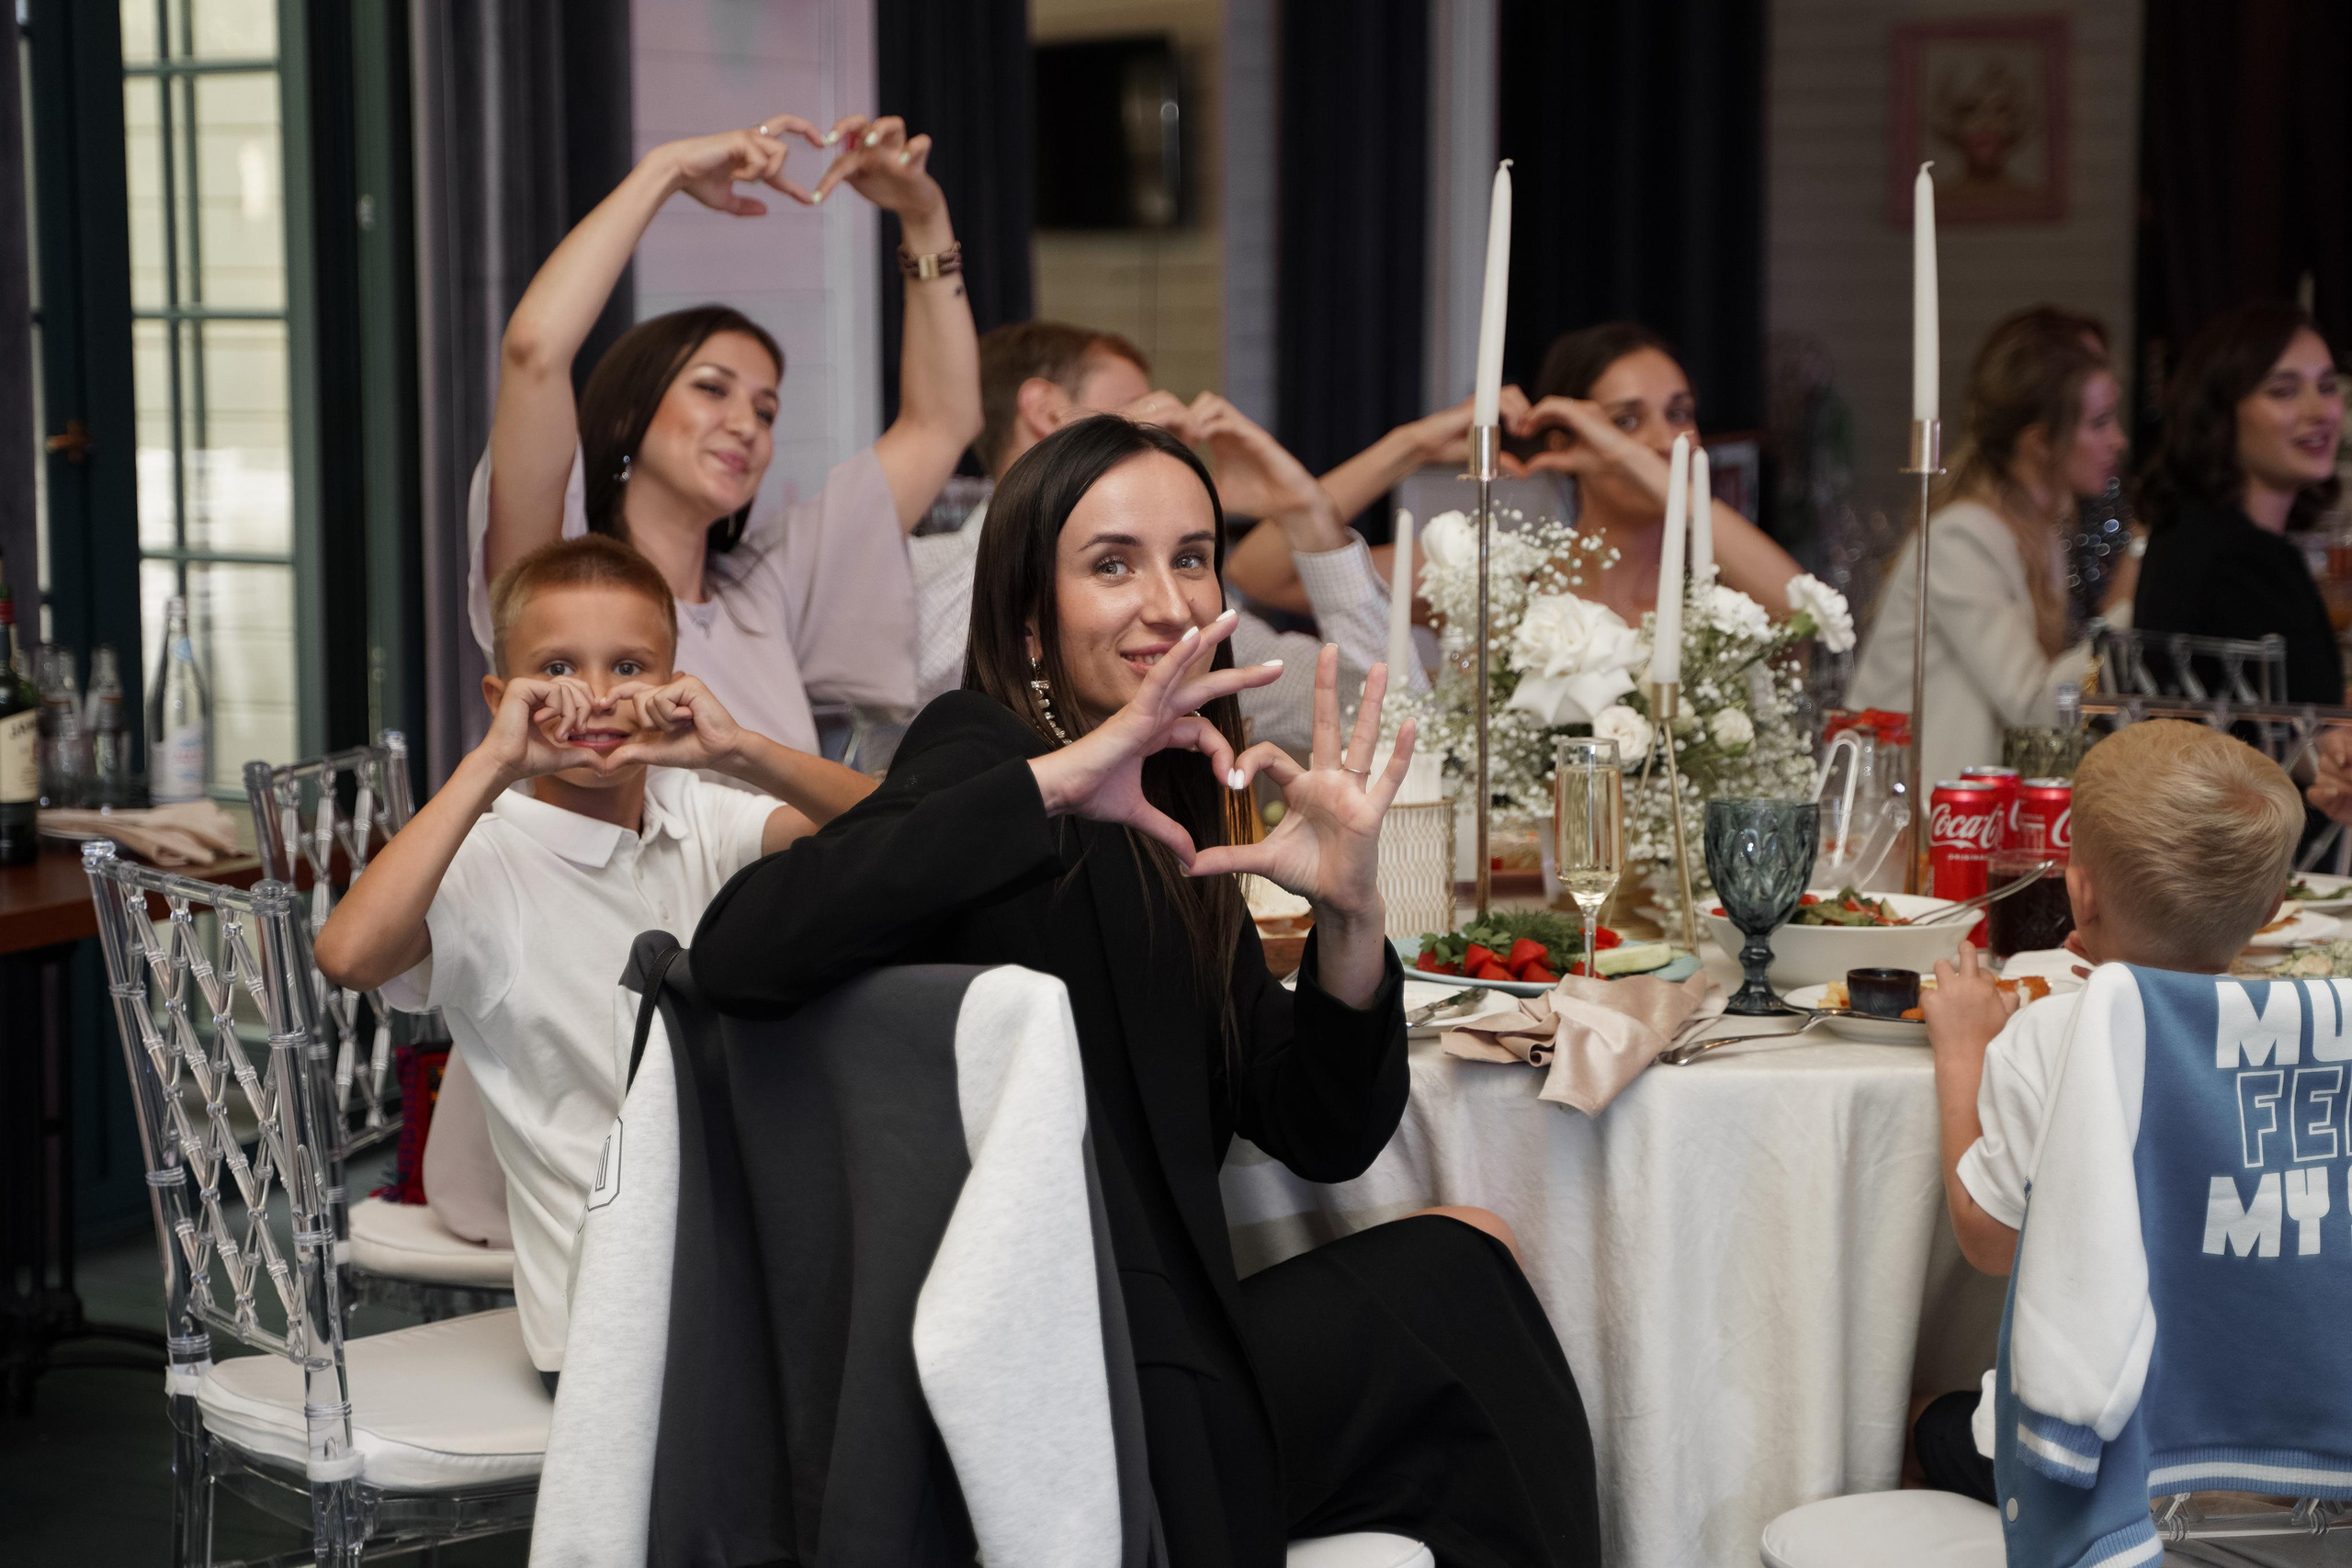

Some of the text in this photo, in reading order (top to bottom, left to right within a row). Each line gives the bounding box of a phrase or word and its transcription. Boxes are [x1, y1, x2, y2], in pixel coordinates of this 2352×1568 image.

[2215, 977, 2352, 1068] MU
[2236, 1066, 2352, 1168] FE
[2202, 1166, 2330, 1258] MY
